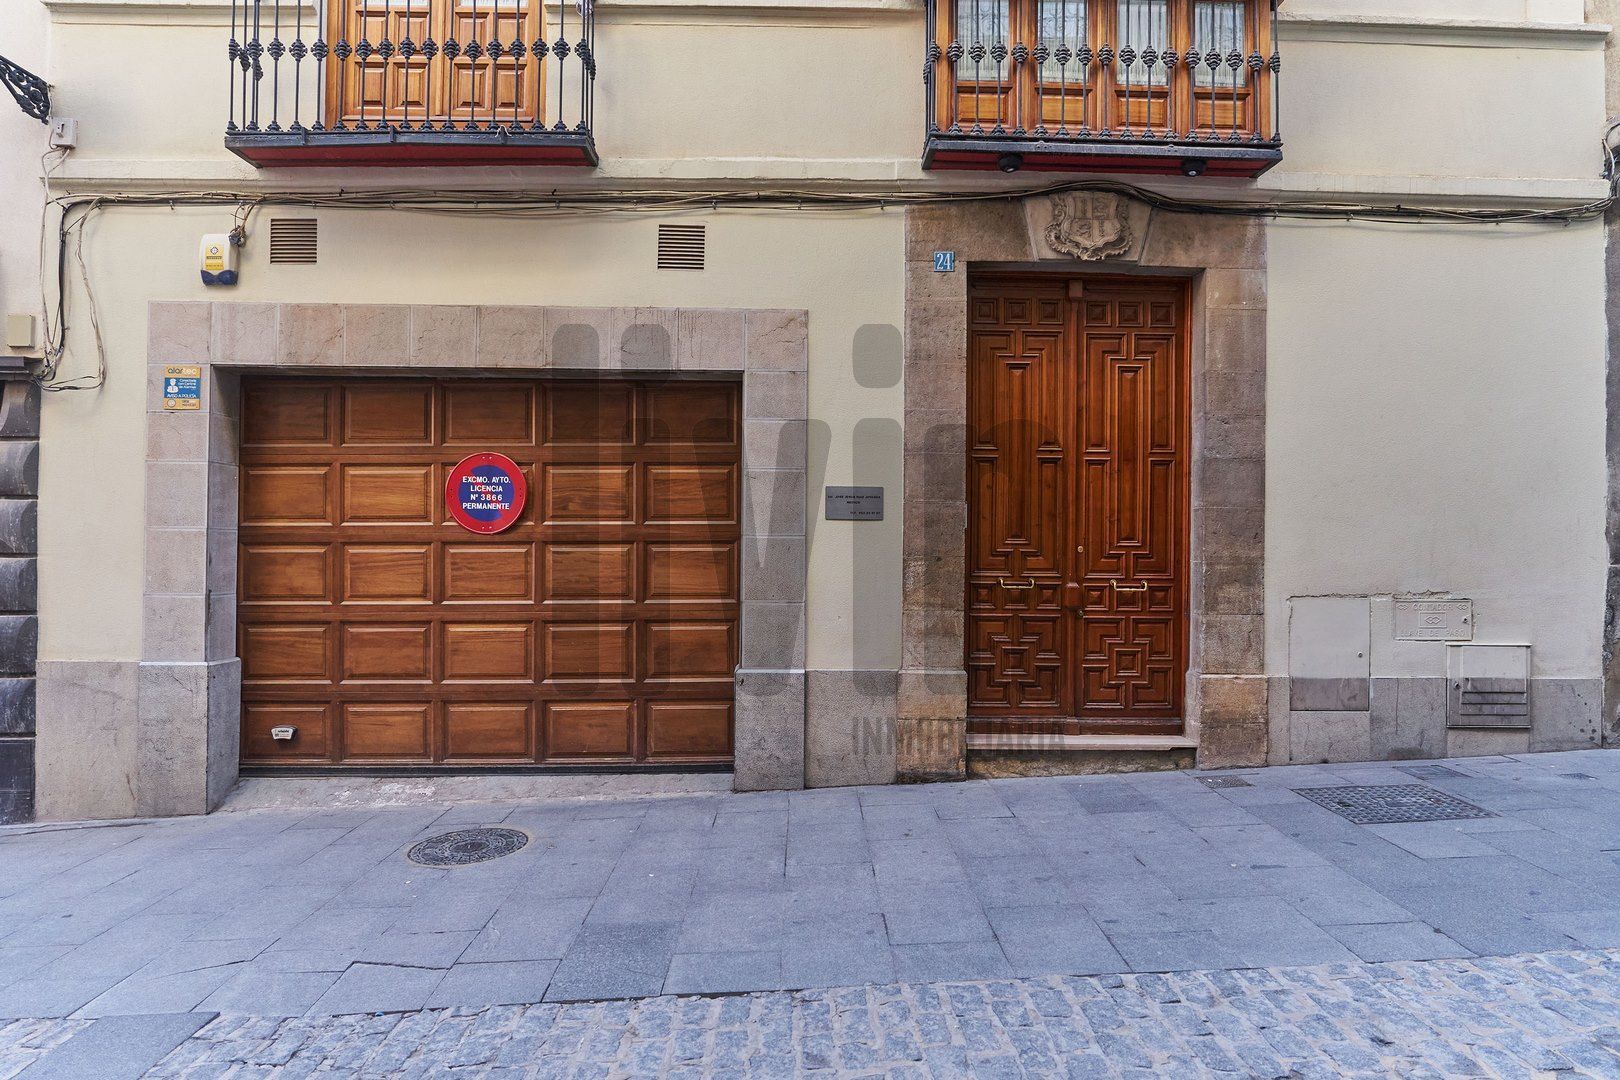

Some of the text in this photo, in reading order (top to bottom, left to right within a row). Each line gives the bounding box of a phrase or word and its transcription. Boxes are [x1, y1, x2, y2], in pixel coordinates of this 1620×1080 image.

[936, 253, 951, 270] 24
[462, 476, 511, 484] EXCMO. AYTO.
[462, 502, 510, 510] PERMANENTE
